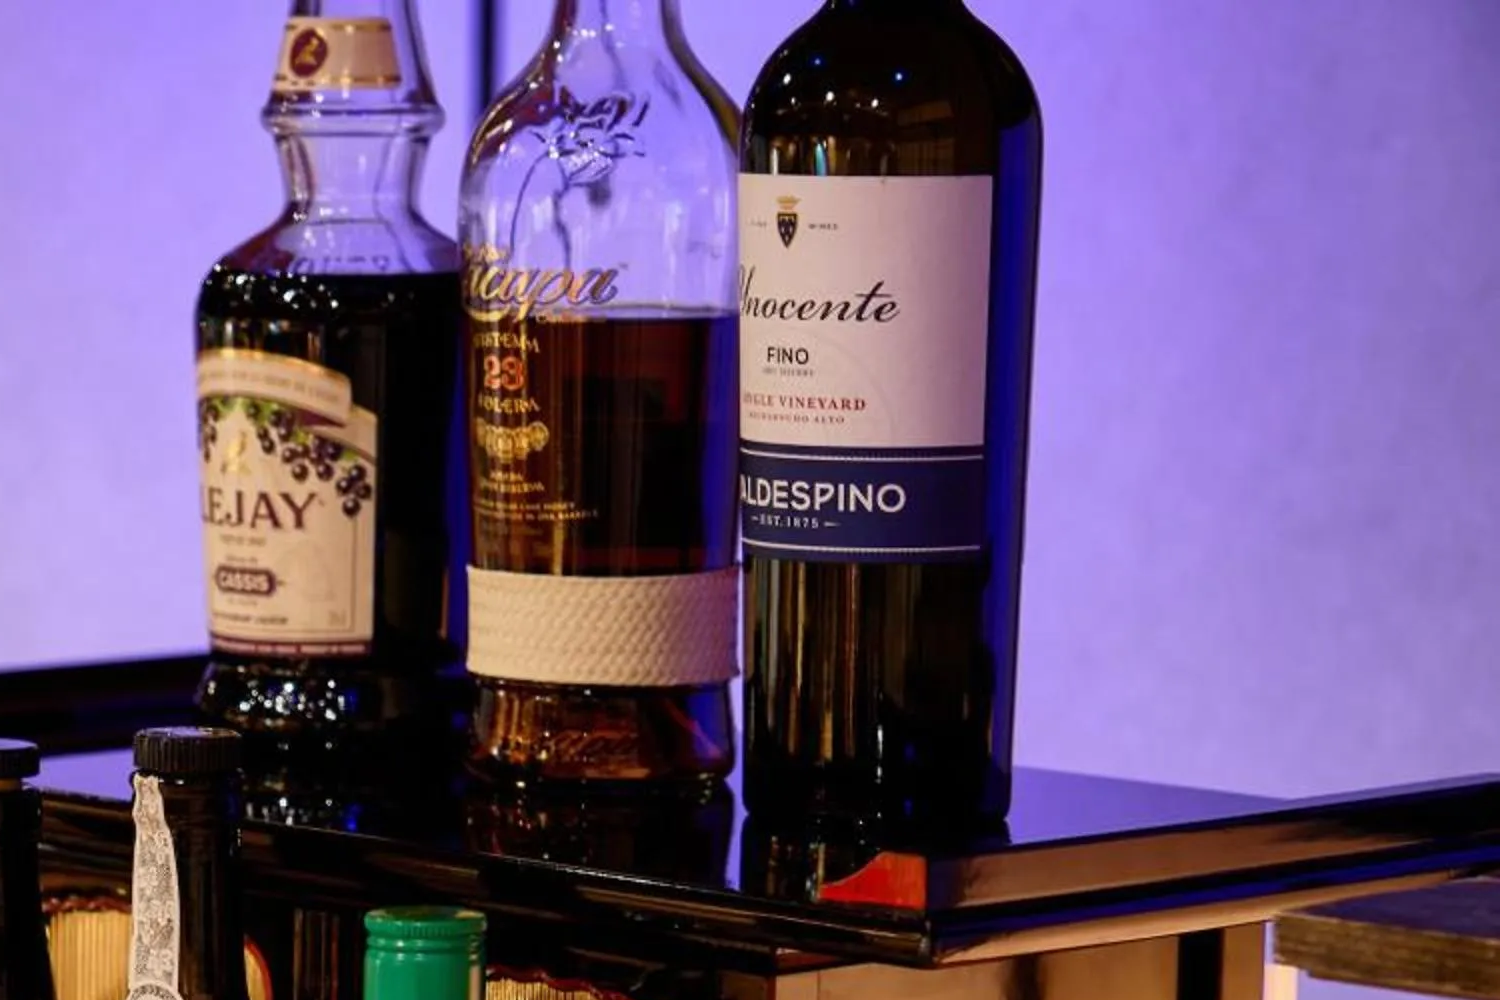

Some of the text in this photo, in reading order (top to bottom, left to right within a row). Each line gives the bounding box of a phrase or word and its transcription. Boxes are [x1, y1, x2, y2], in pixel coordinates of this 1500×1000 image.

[767, 346, 810, 366] FINO
[484, 355, 525, 391] 23
[779, 394, 866, 411] VINEYARD
[740, 473, 906, 513] ALDESPINO
